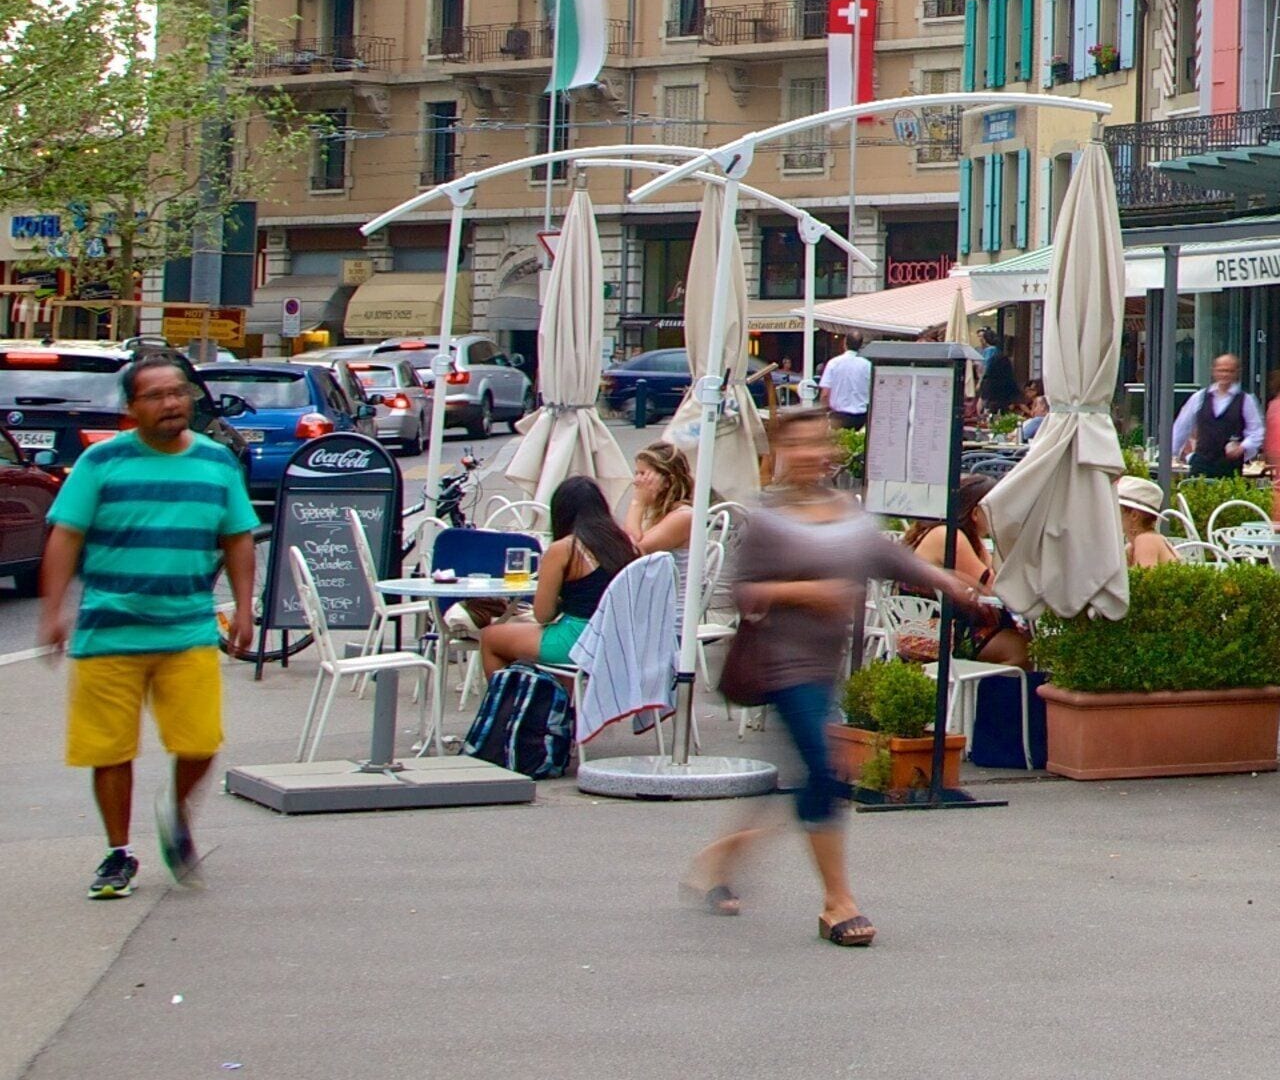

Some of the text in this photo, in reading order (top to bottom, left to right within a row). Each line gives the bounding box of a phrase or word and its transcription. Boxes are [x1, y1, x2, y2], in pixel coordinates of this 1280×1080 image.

[12, 214, 60, 237] HOTEL
[184, 310, 220, 319] HOTLS
[308, 448, 374, 468] Coca-Cola
